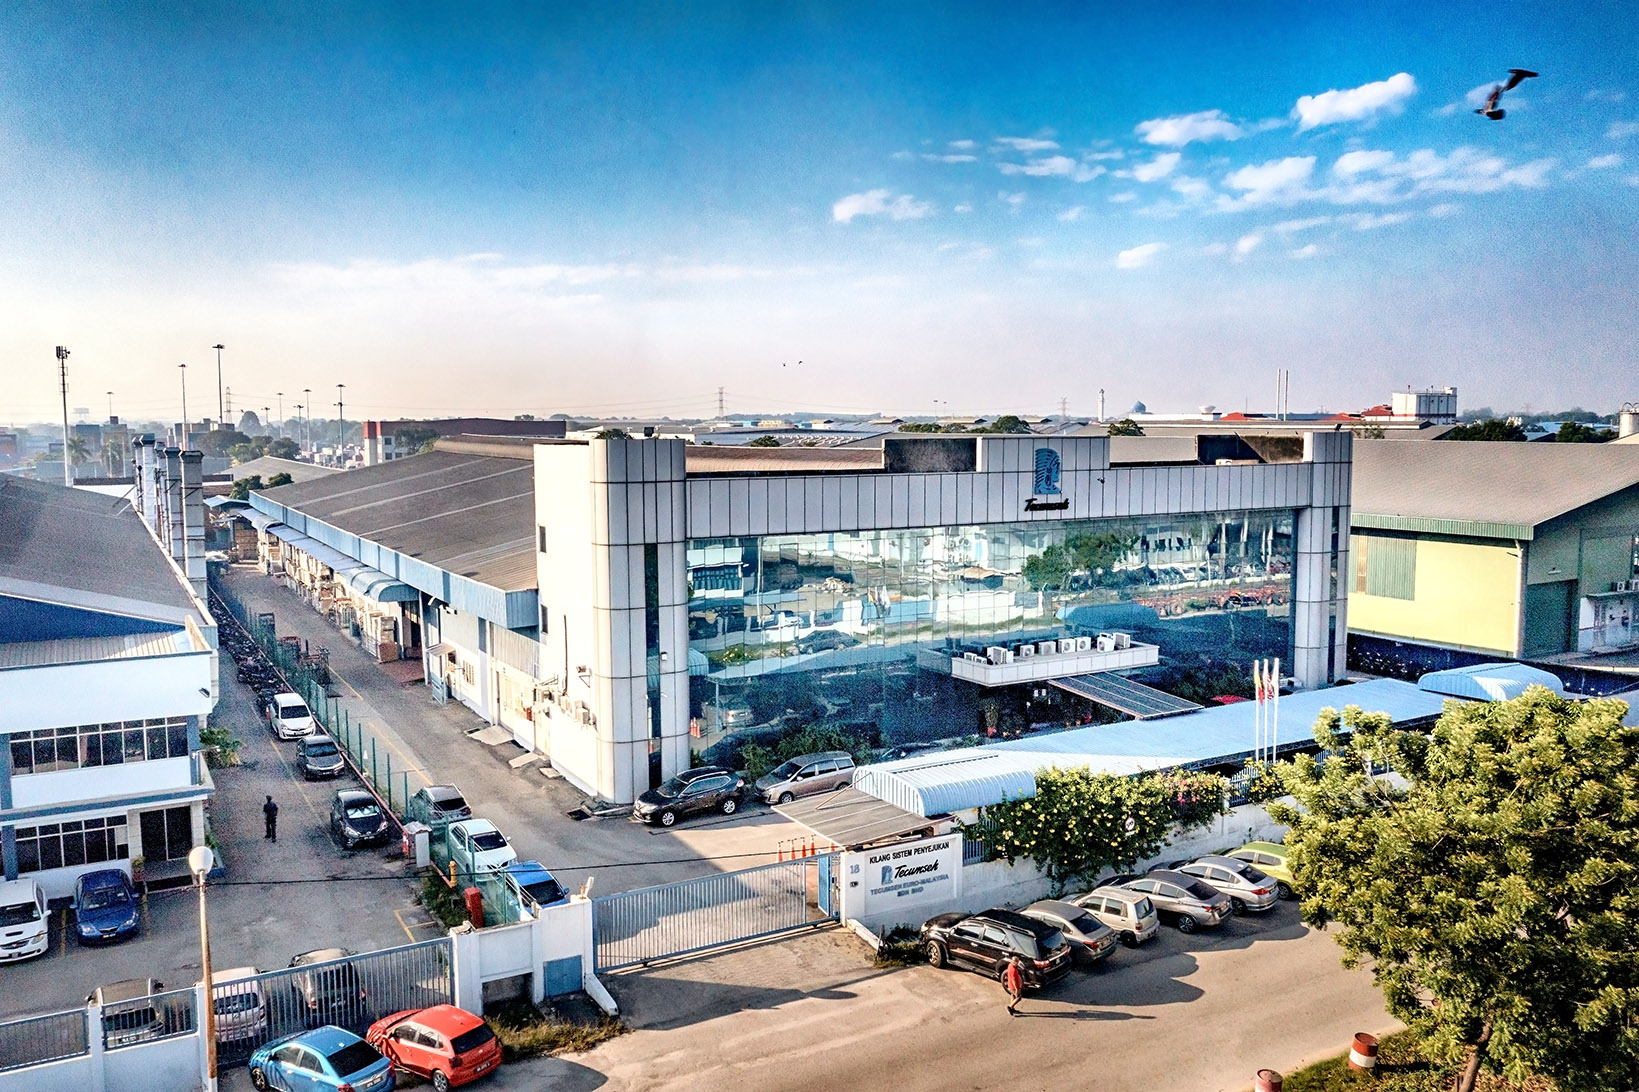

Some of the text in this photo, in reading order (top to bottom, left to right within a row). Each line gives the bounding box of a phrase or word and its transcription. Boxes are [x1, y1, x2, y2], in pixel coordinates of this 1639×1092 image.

[869, 841, 950, 864] KILANG SISTEM PENYEJUKAN
[849, 864, 860, 874] 18
[894, 859, 939, 879] Tecumseh
